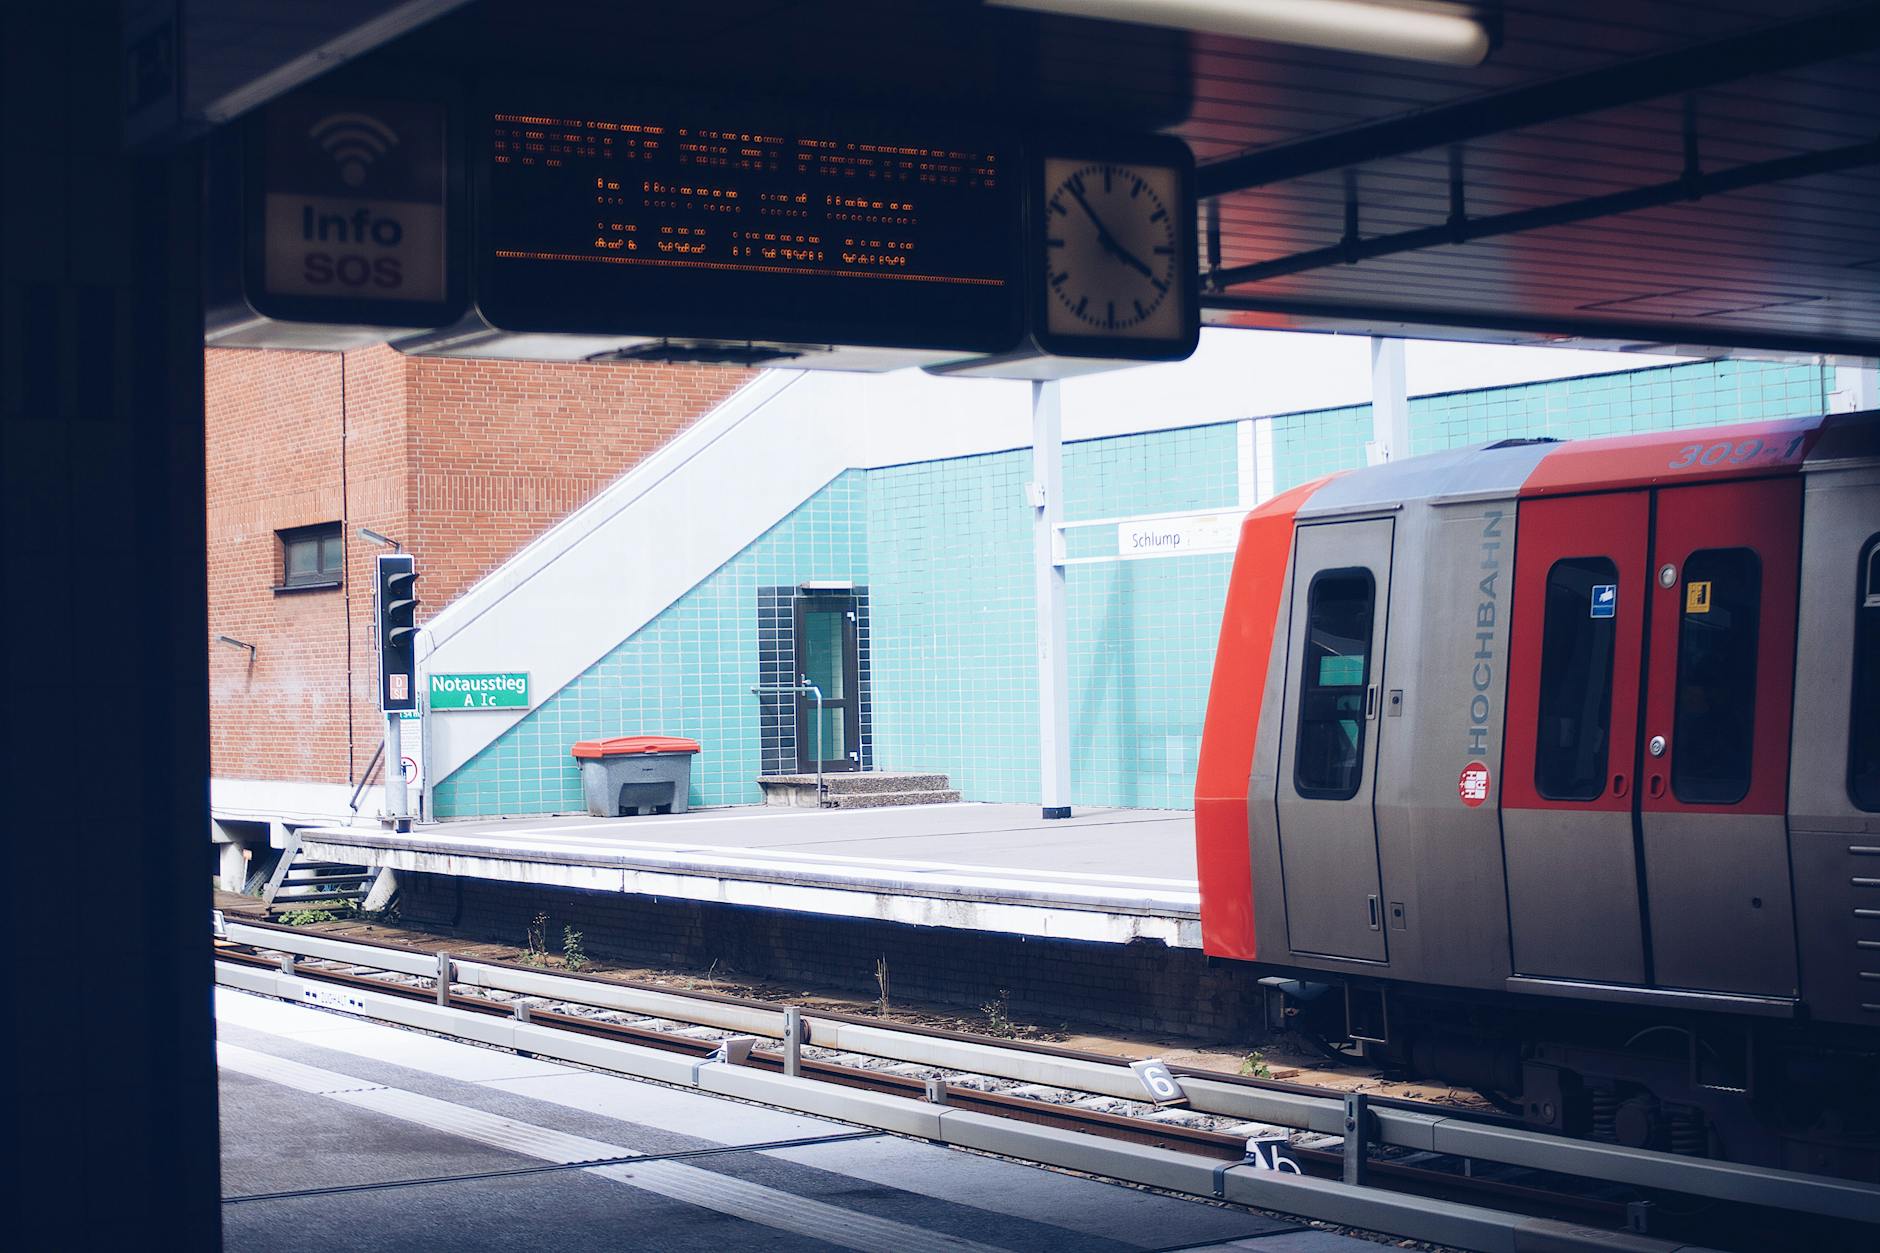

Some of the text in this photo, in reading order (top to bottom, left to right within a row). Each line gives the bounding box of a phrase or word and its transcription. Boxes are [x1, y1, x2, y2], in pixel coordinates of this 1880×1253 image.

[303, 205, 402, 246] Info
[303, 252, 403, 288] SOS
[1669, 436, 1804, 469] 309-1
[1132, 531, 1181, 548] Schlump
[1467, 511, 1503, 755] HOCHBAHN
[432, 675, 526, 694] Notausstieg
[463, 693, 497, 707] A Ic
[1144, 1067, 1174, 1097] 6
